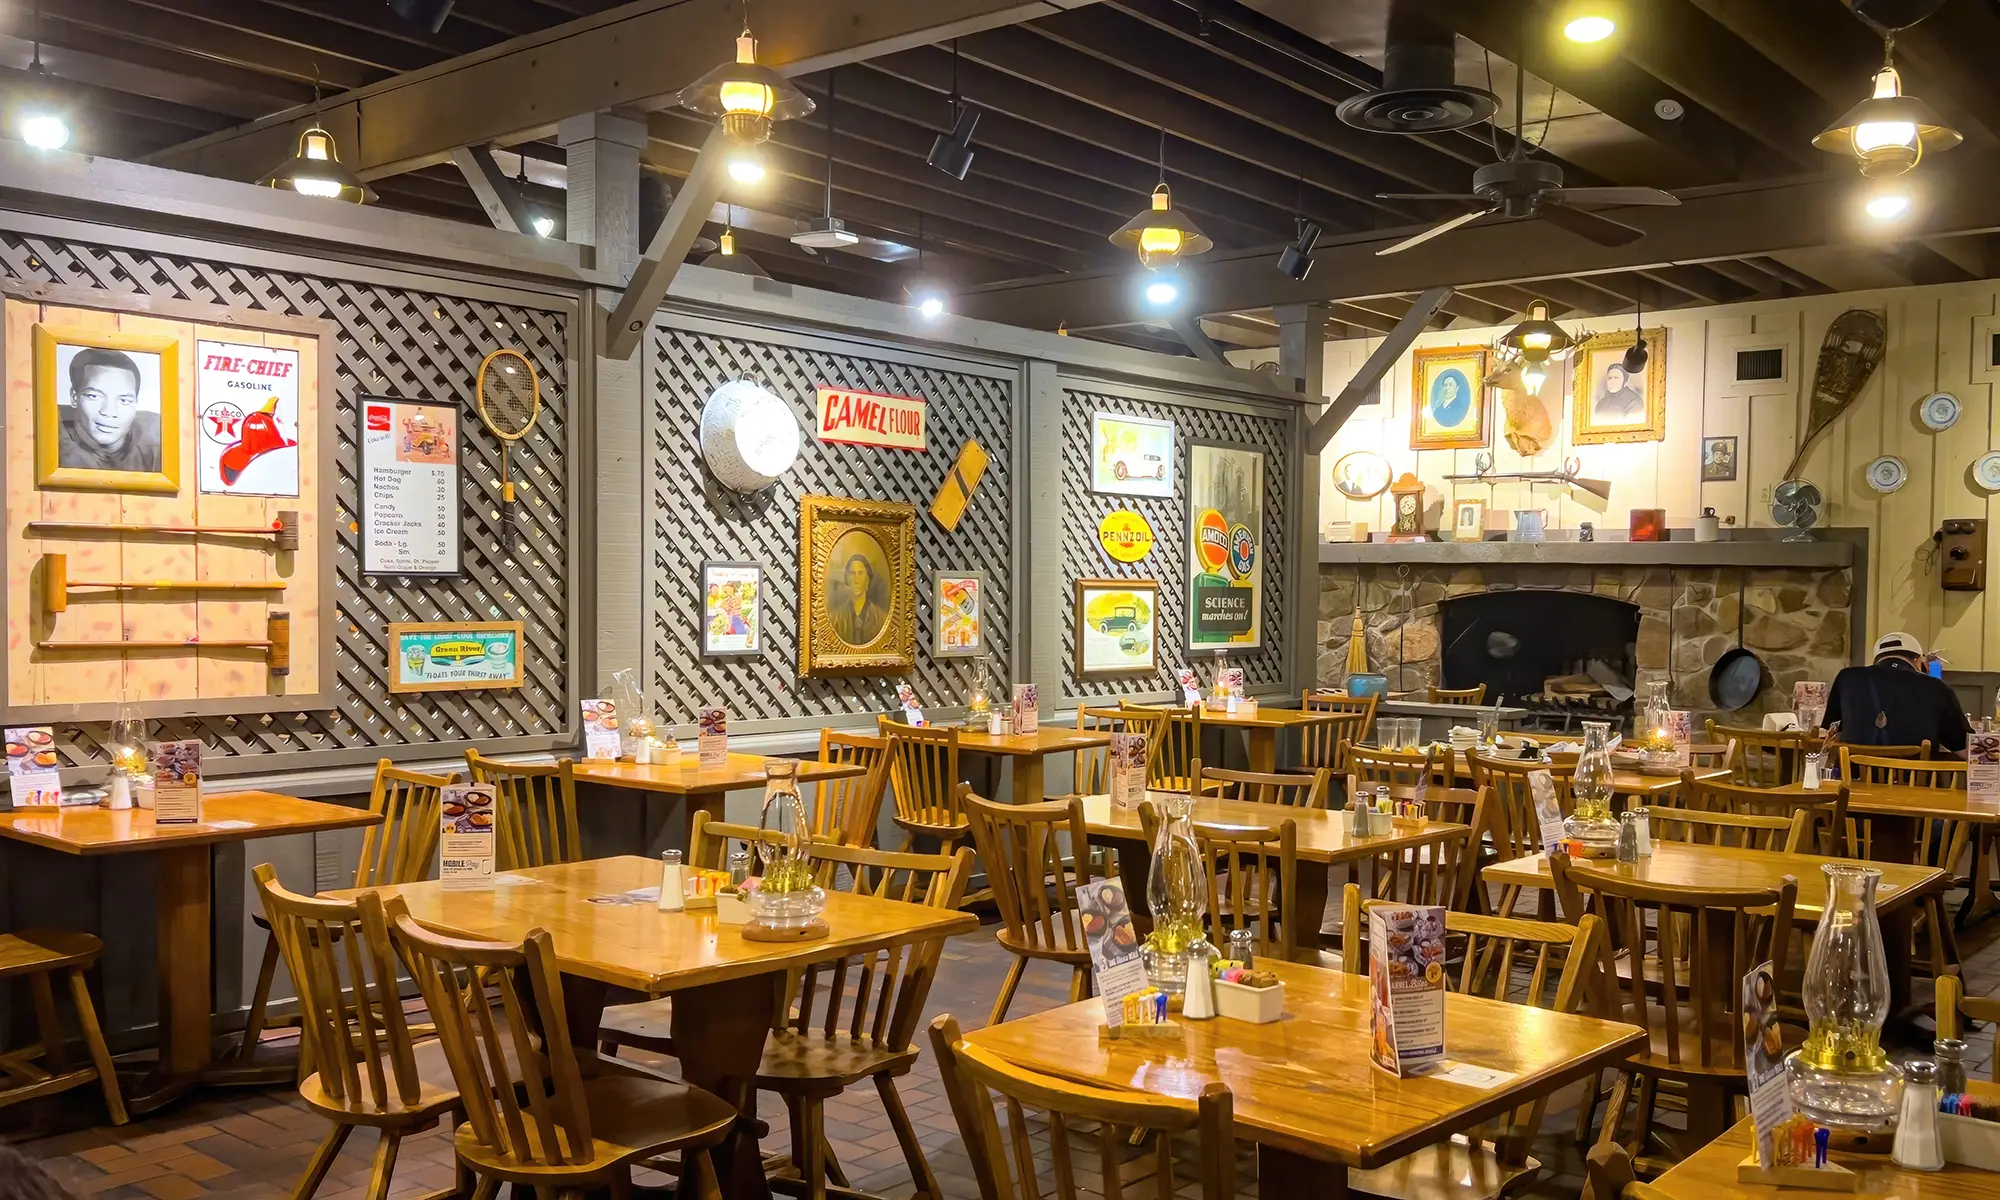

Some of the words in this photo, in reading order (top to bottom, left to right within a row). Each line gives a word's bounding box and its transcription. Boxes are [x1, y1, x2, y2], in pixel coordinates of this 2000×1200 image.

[204, 354, 293, 377] FIRE-CHIEF
[228, 380, 272, 392] GASOLINE
[210, 408, 242, 418] TEXACO
[823, 394, 887, 435] CAMEL
[889, 408, 920, 436] FLOUR
[373, 467, 411, 476] Hamburger
[387, 476, 401, 484] Dog
[374, 503, 395, 511] Candy
[374, 511, 403, 519] Popcorn
[1103, 532, 1150, 542] PENNZOIL
[1202, 528, 1228, 548] AMOCO
[1238, 560, 1250, 572] GAS
[1205, 597, 1246, 608] SCIENCE
[1202, 609, 1234, 620] marches
[1234, 610, 1248, 620] on!
[468, 670, 487, 678] THIRST
